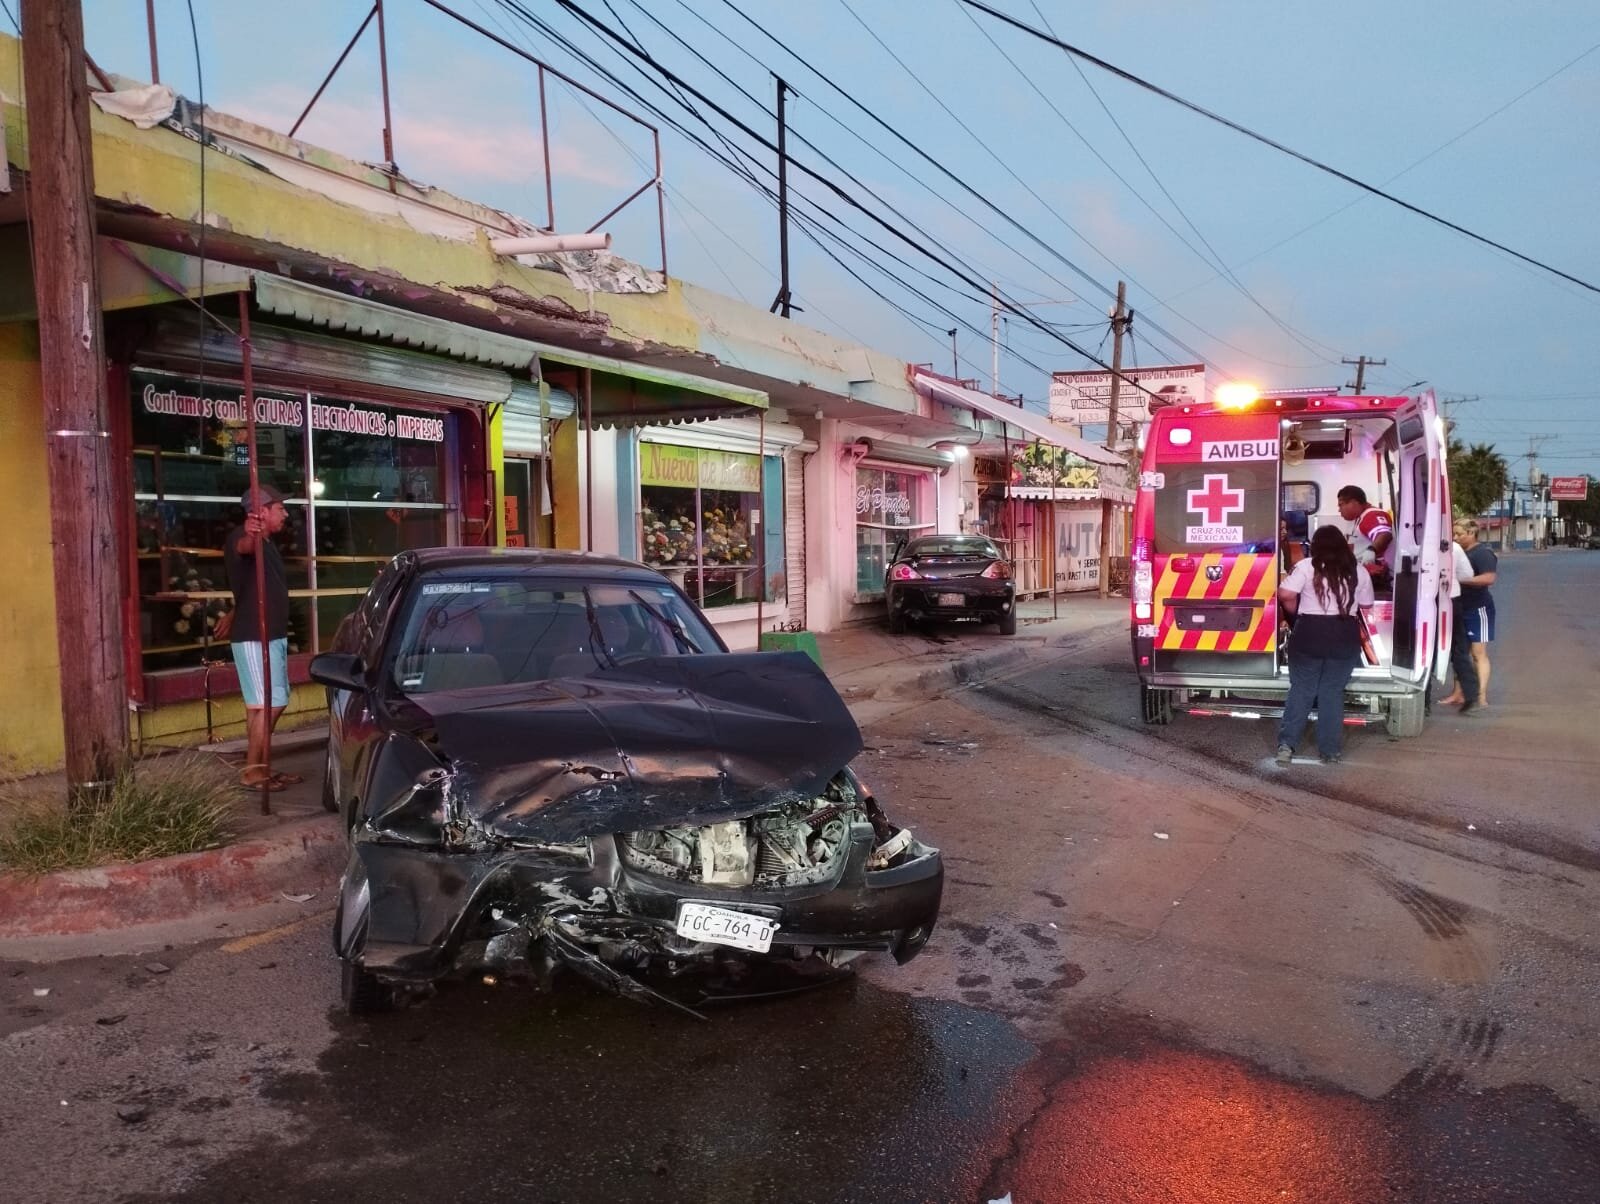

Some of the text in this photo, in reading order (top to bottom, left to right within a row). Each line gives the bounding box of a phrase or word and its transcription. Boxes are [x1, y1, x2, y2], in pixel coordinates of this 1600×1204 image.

[1075, 374, 1103, 383] CLIMAS
[144, 384, 212, 418] Contamos
[214, 399, 238, 420] con
[239, 395, 303, 427] FCTURAS
[312, 403, 386, 436] ELECTRÓNICAS
[397, 414, 444, 442] IMPRESAS
[1208, 442, 1279, 459] AMBUL
[648, 445, 696, 482] Nueva
[701, 451, 717, 484] de
[856, 485, 870, 514] El
[1190, 534, 1239, 542] MEXICANA
[1191, 527, 1238, 535] CRUZ ROJA
[682, 914, 770, 941] FGC-764-D
